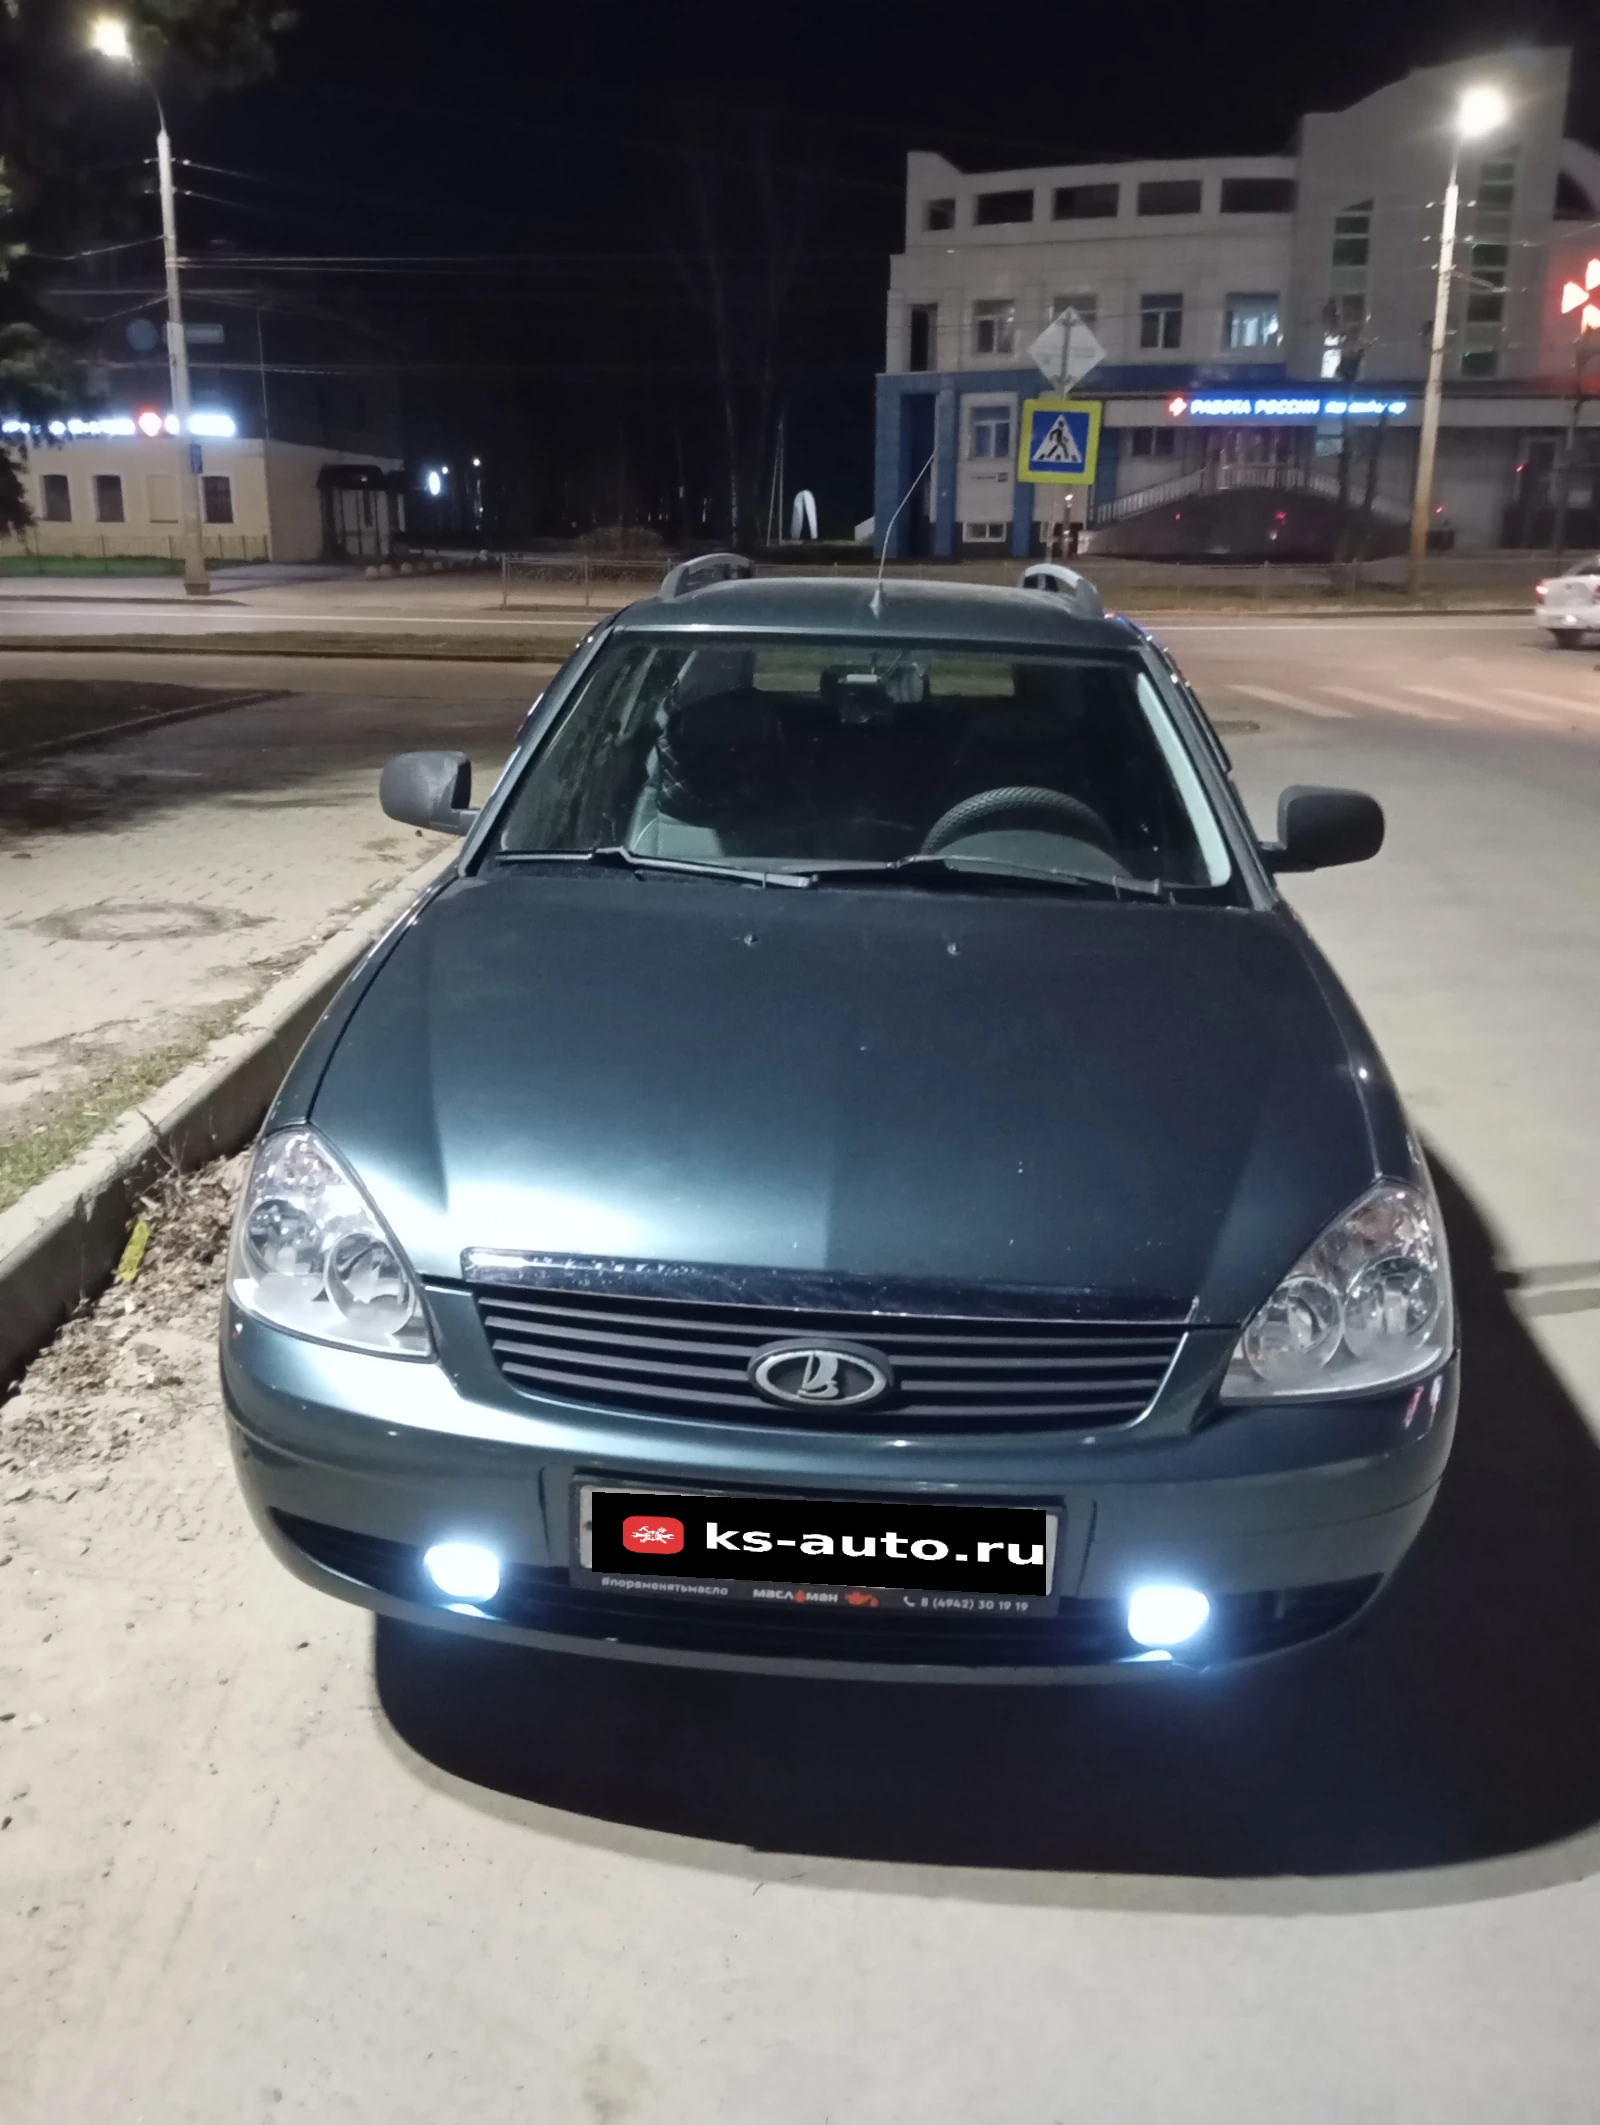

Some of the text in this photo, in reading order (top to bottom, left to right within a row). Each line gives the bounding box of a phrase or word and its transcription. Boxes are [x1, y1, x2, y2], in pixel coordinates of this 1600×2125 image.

[932, 1597, 974, 1611] (4942)
[978, 1599, 995, 1611] 30
[998, 1600, 1012, 1611] 19
[1015, 1601, 1029, 1612] 19
